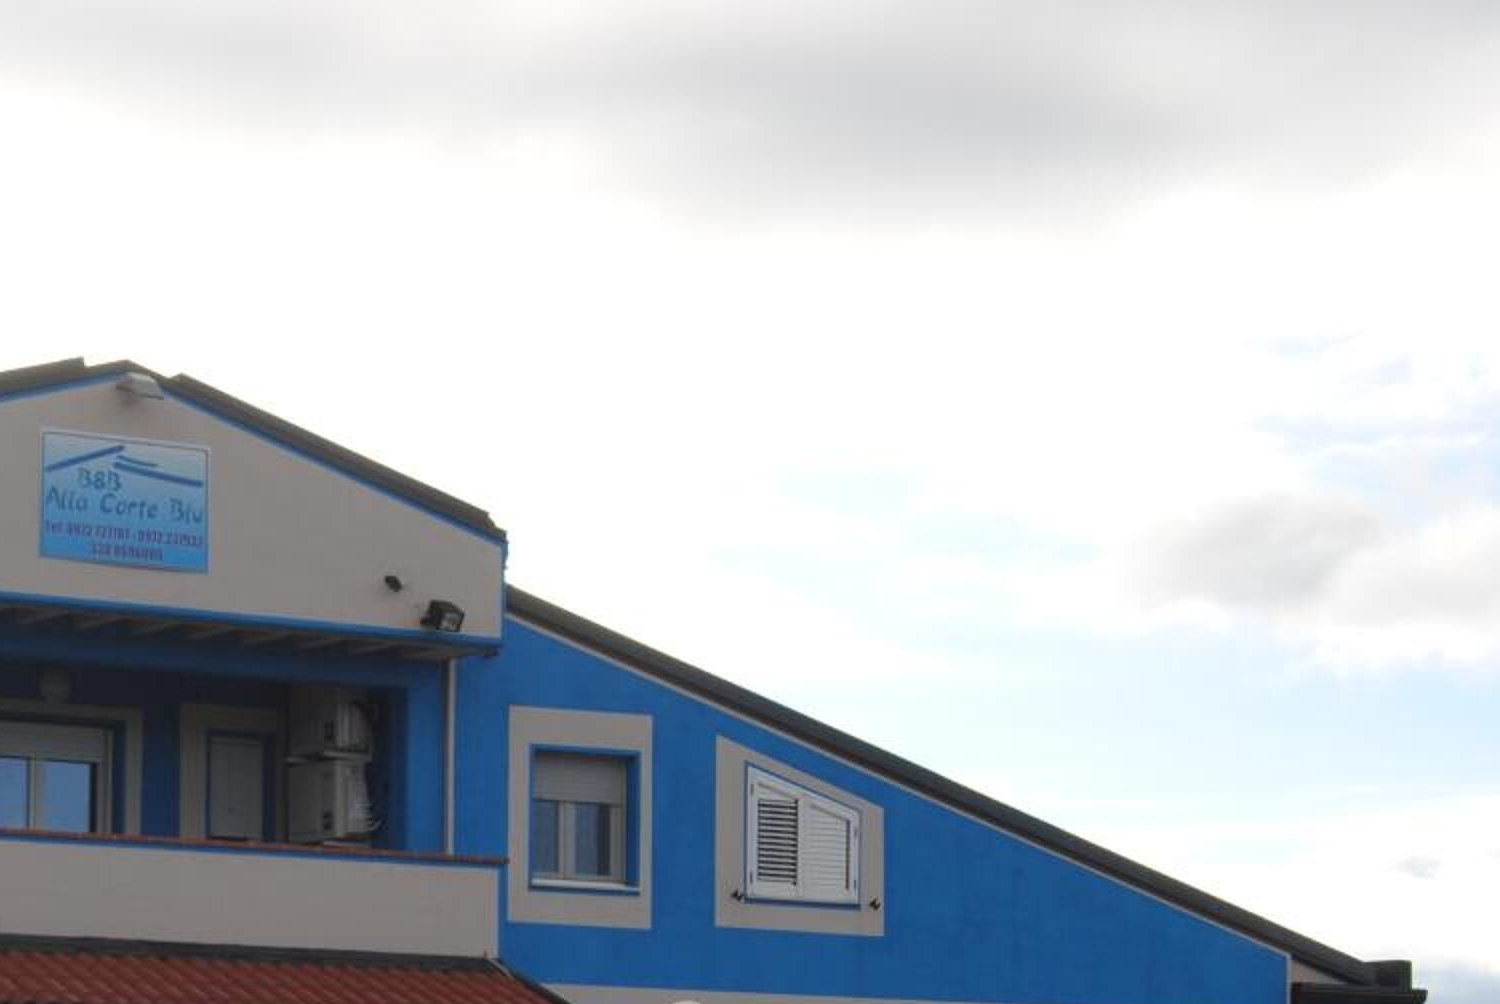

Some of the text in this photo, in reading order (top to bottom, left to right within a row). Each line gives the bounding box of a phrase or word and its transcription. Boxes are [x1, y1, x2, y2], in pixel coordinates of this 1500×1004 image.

[46, 486, 203, 524] Alla Corte Blu
